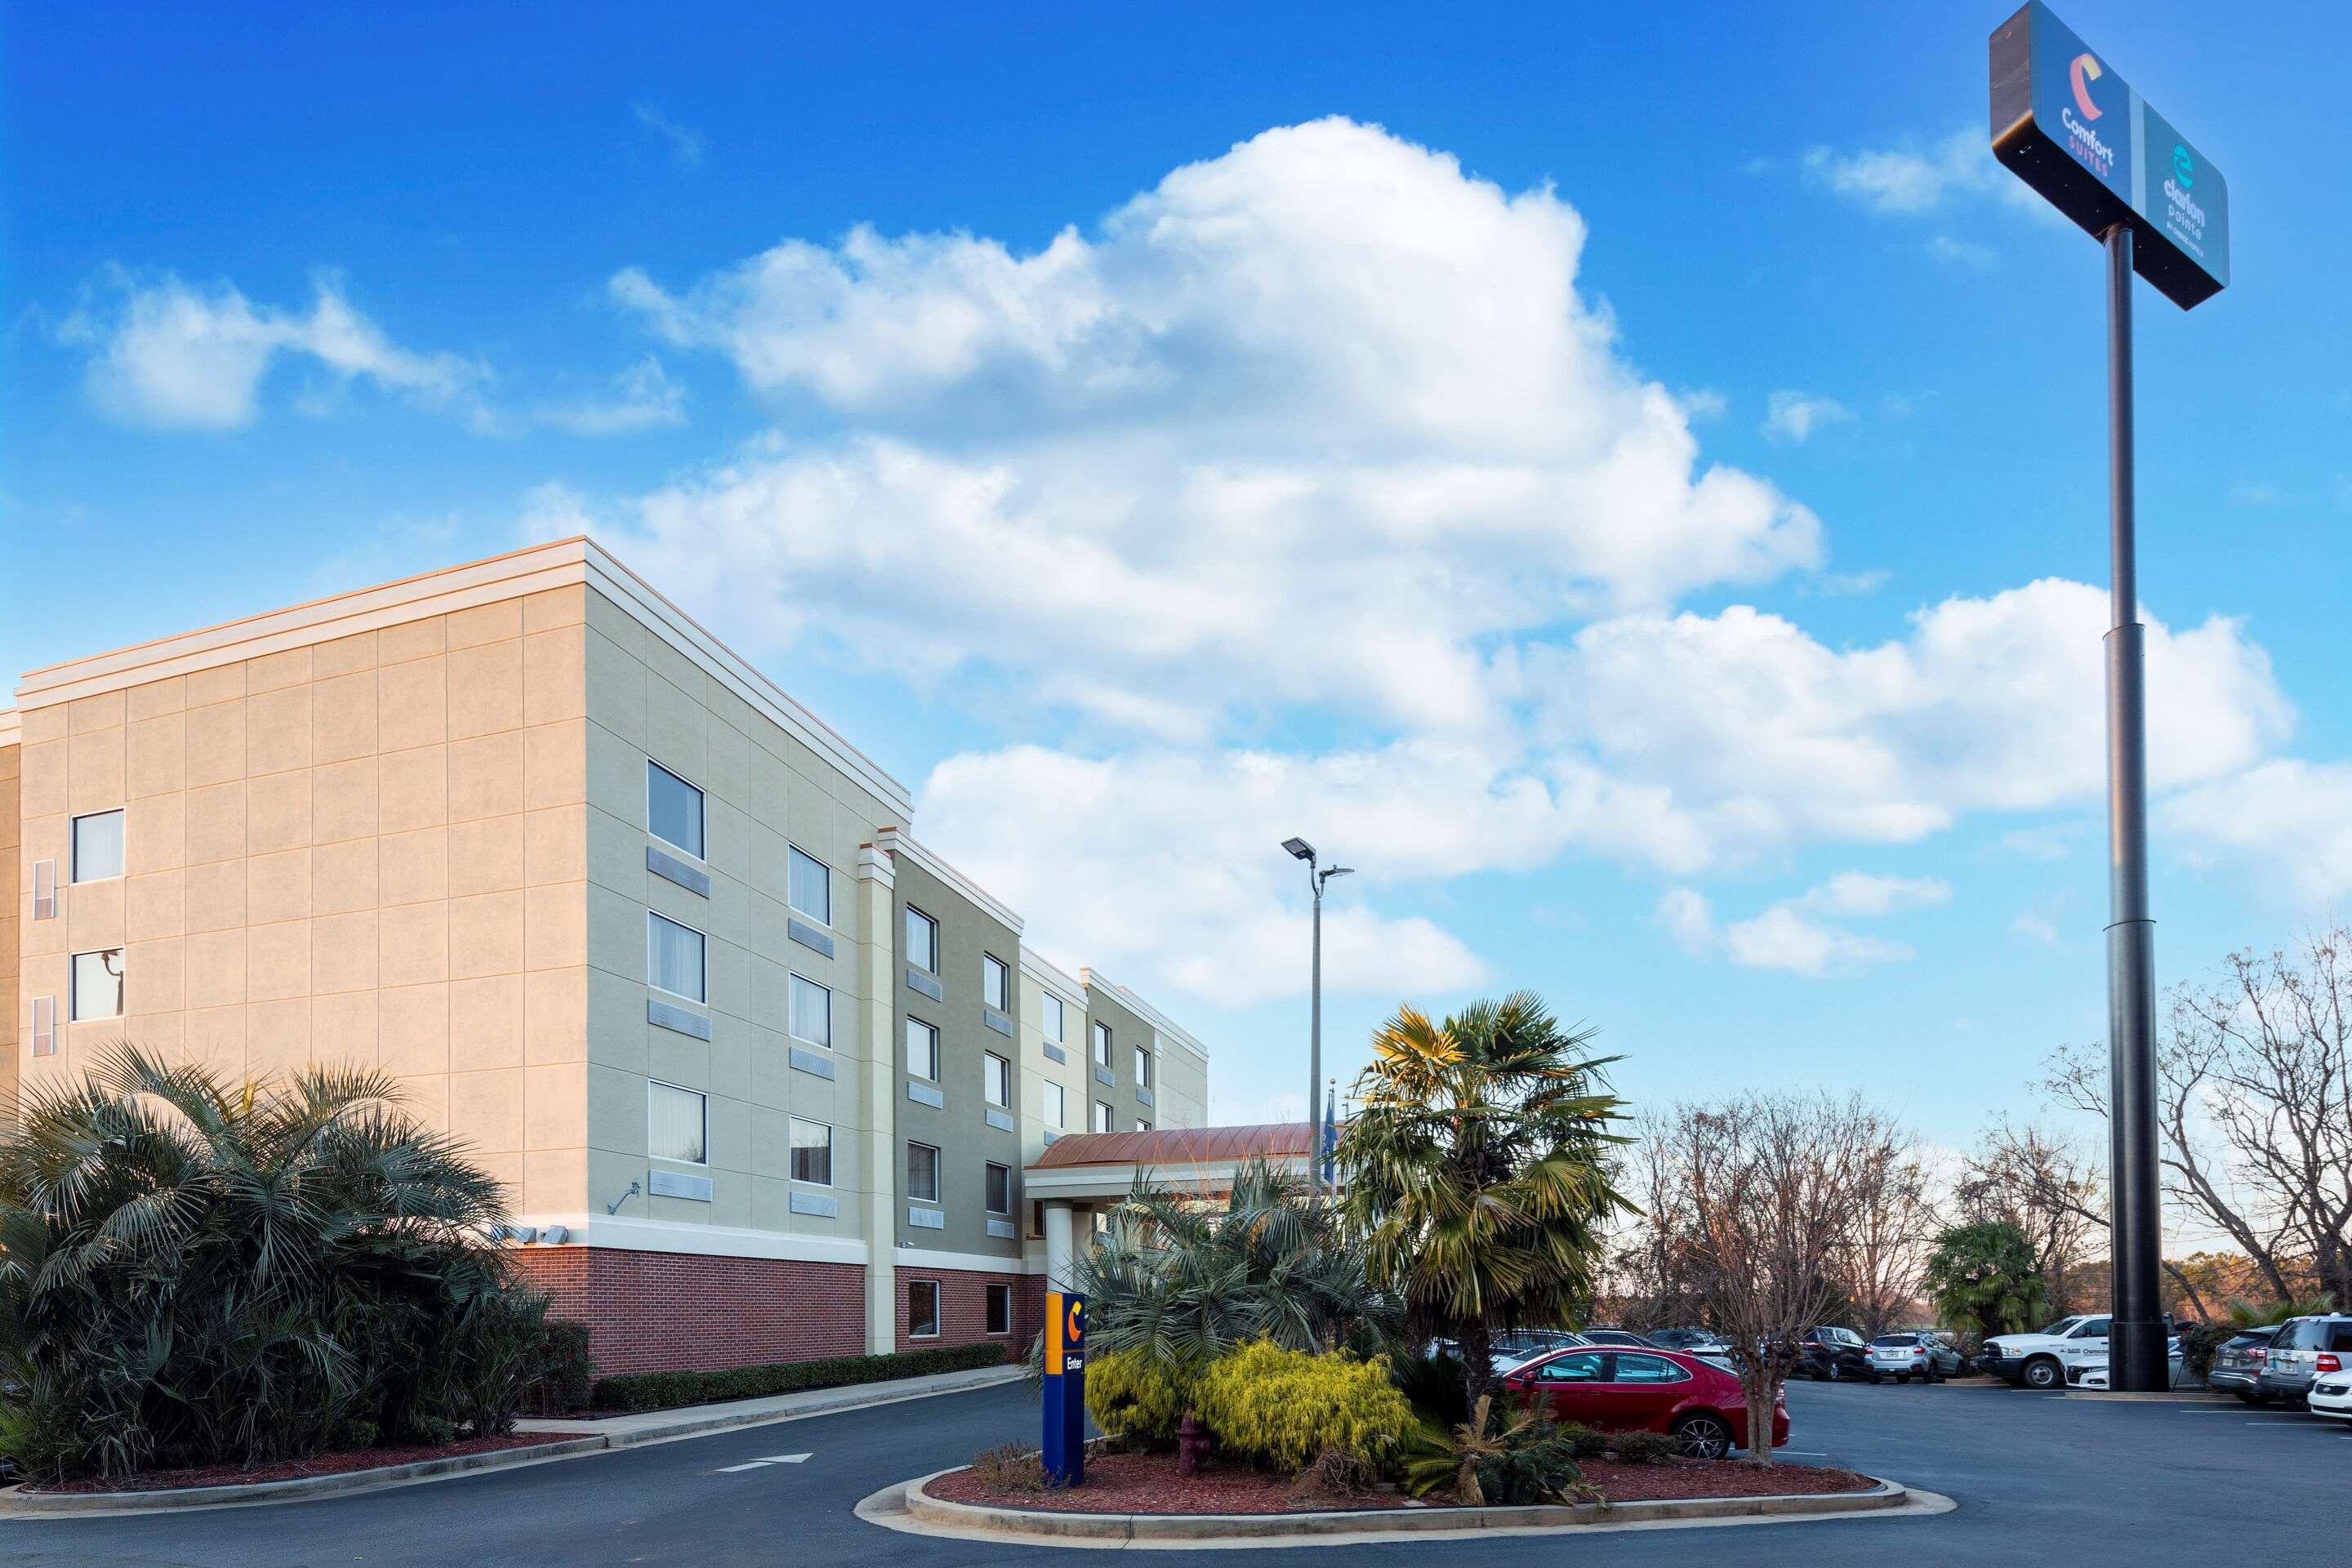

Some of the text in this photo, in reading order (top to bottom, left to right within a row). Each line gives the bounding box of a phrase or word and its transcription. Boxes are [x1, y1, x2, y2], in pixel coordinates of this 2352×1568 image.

[2062, 107, 2114, 167] Comfort
[2069, 135, 2108, 177] SUITES
[2164, 179, 2205, 228] clarion
[2168, 203, 2202, 240] pointe
[1067, 1356, 1082, 1370] Enter
